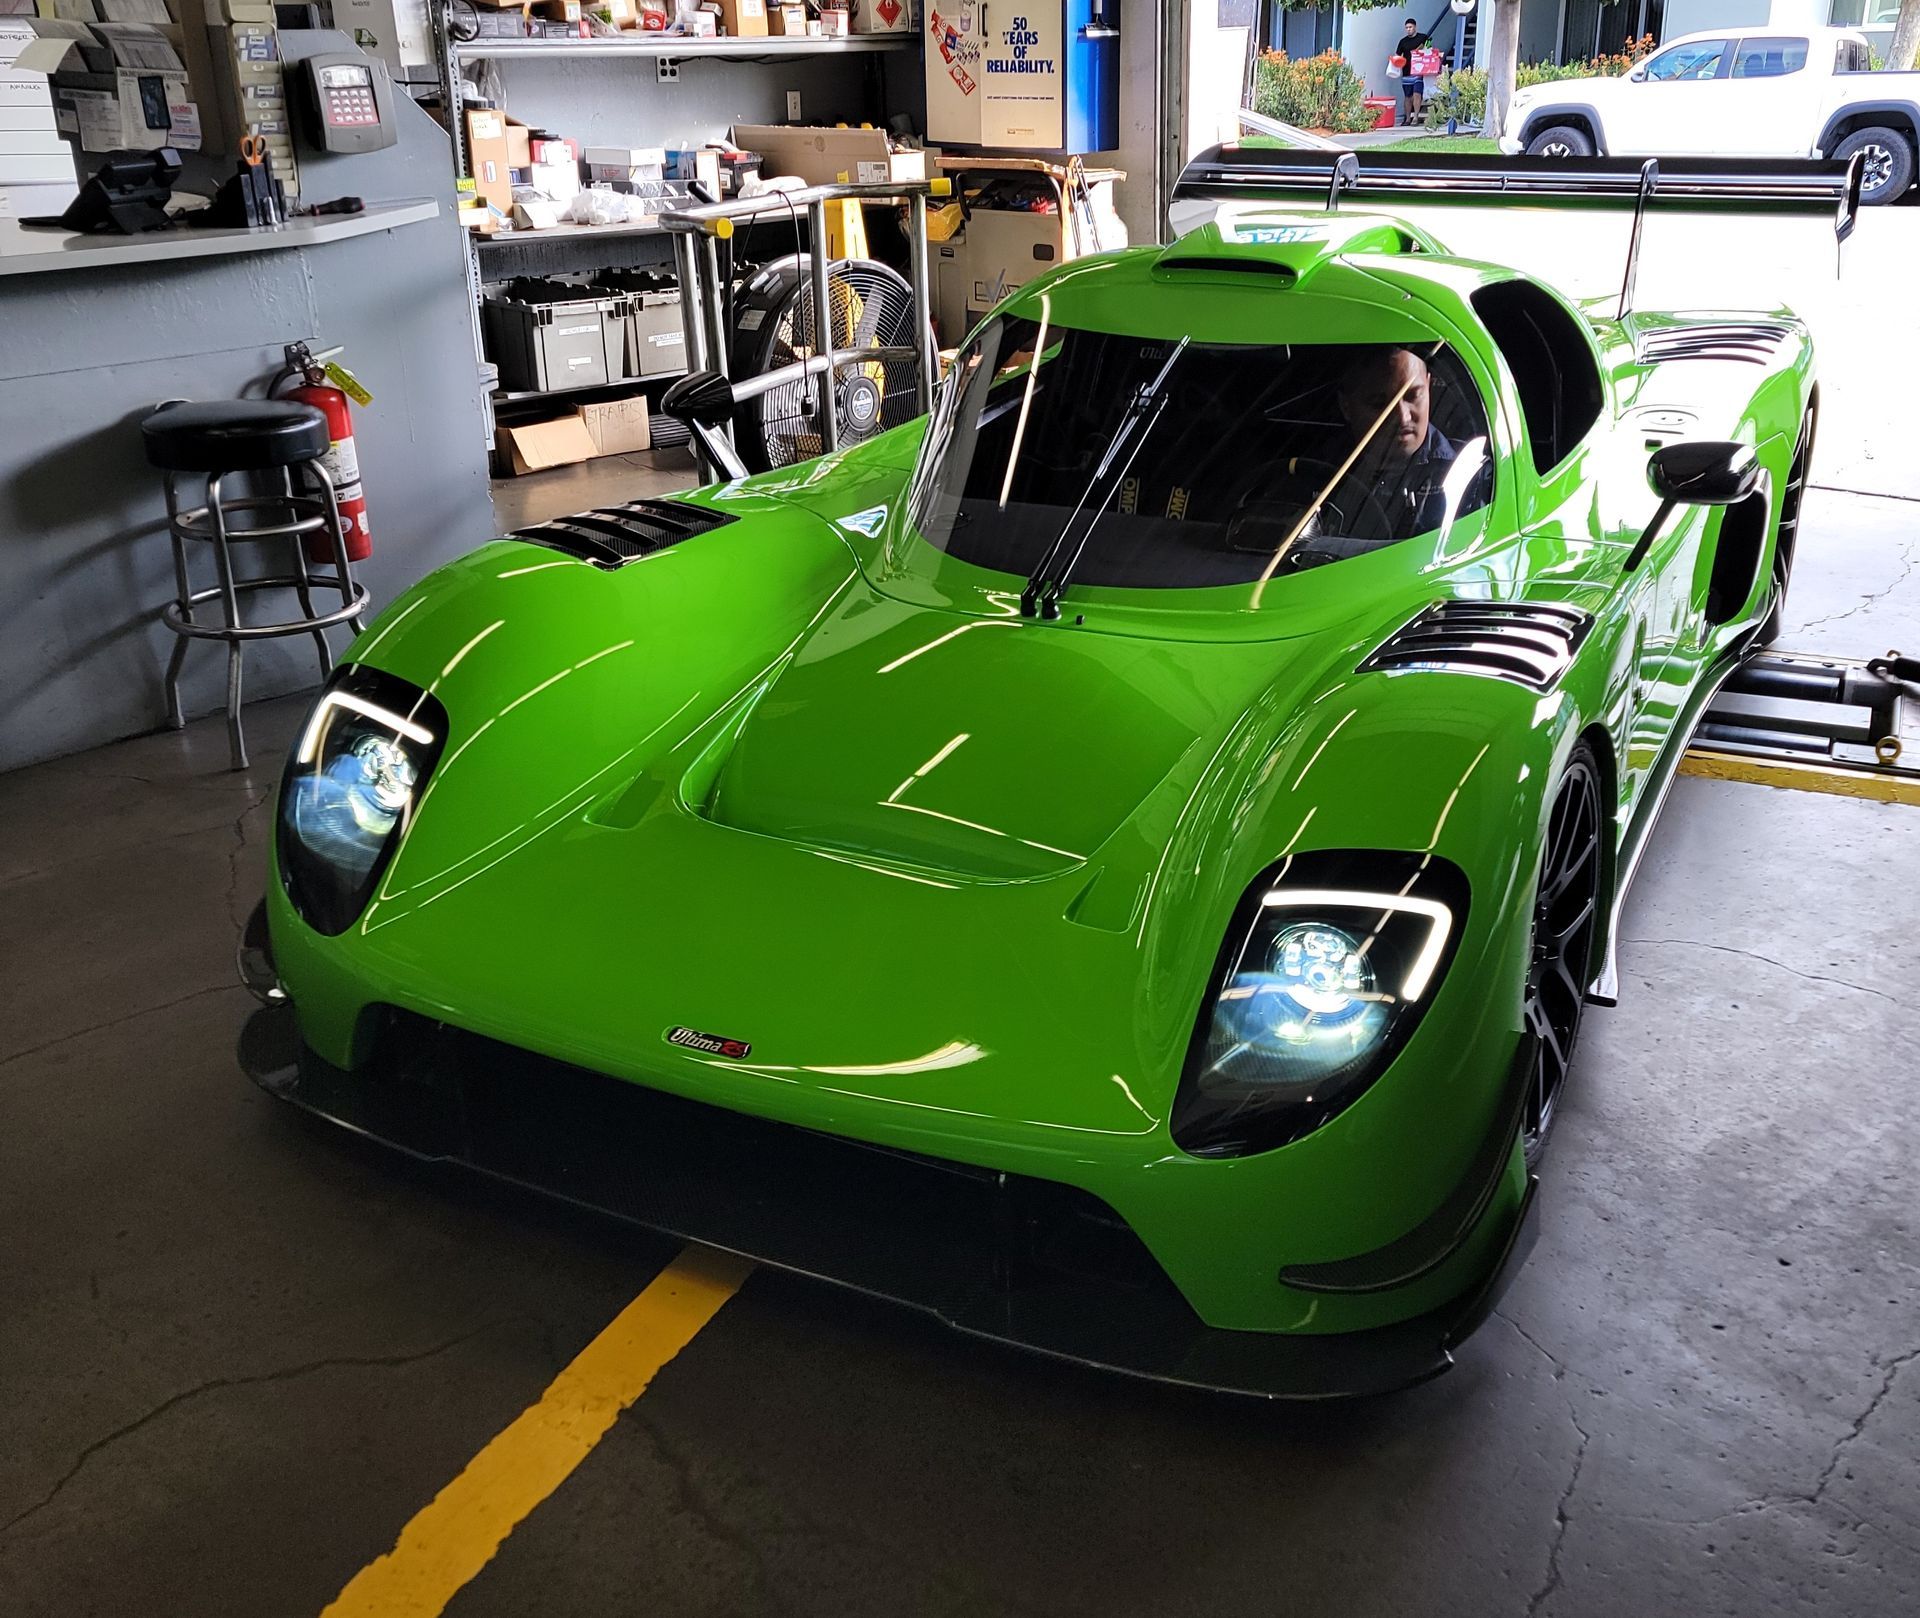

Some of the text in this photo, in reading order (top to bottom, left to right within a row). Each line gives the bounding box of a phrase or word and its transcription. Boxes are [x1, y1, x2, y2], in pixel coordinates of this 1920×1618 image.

[1012, 16, 1028, 31] 50
[1002, 31, 1039, 45] YEARS
[1013, 45, 1028, 59] OF
[986, 59, 1055, 74] RELIABILITY.
[587, 400, 643, 426] STRAPS
[1121, 477, 1137, 514] OMP
[1168, 487, 1186, 520] OMP
[670, 1028, 723, 1052] Ultima
